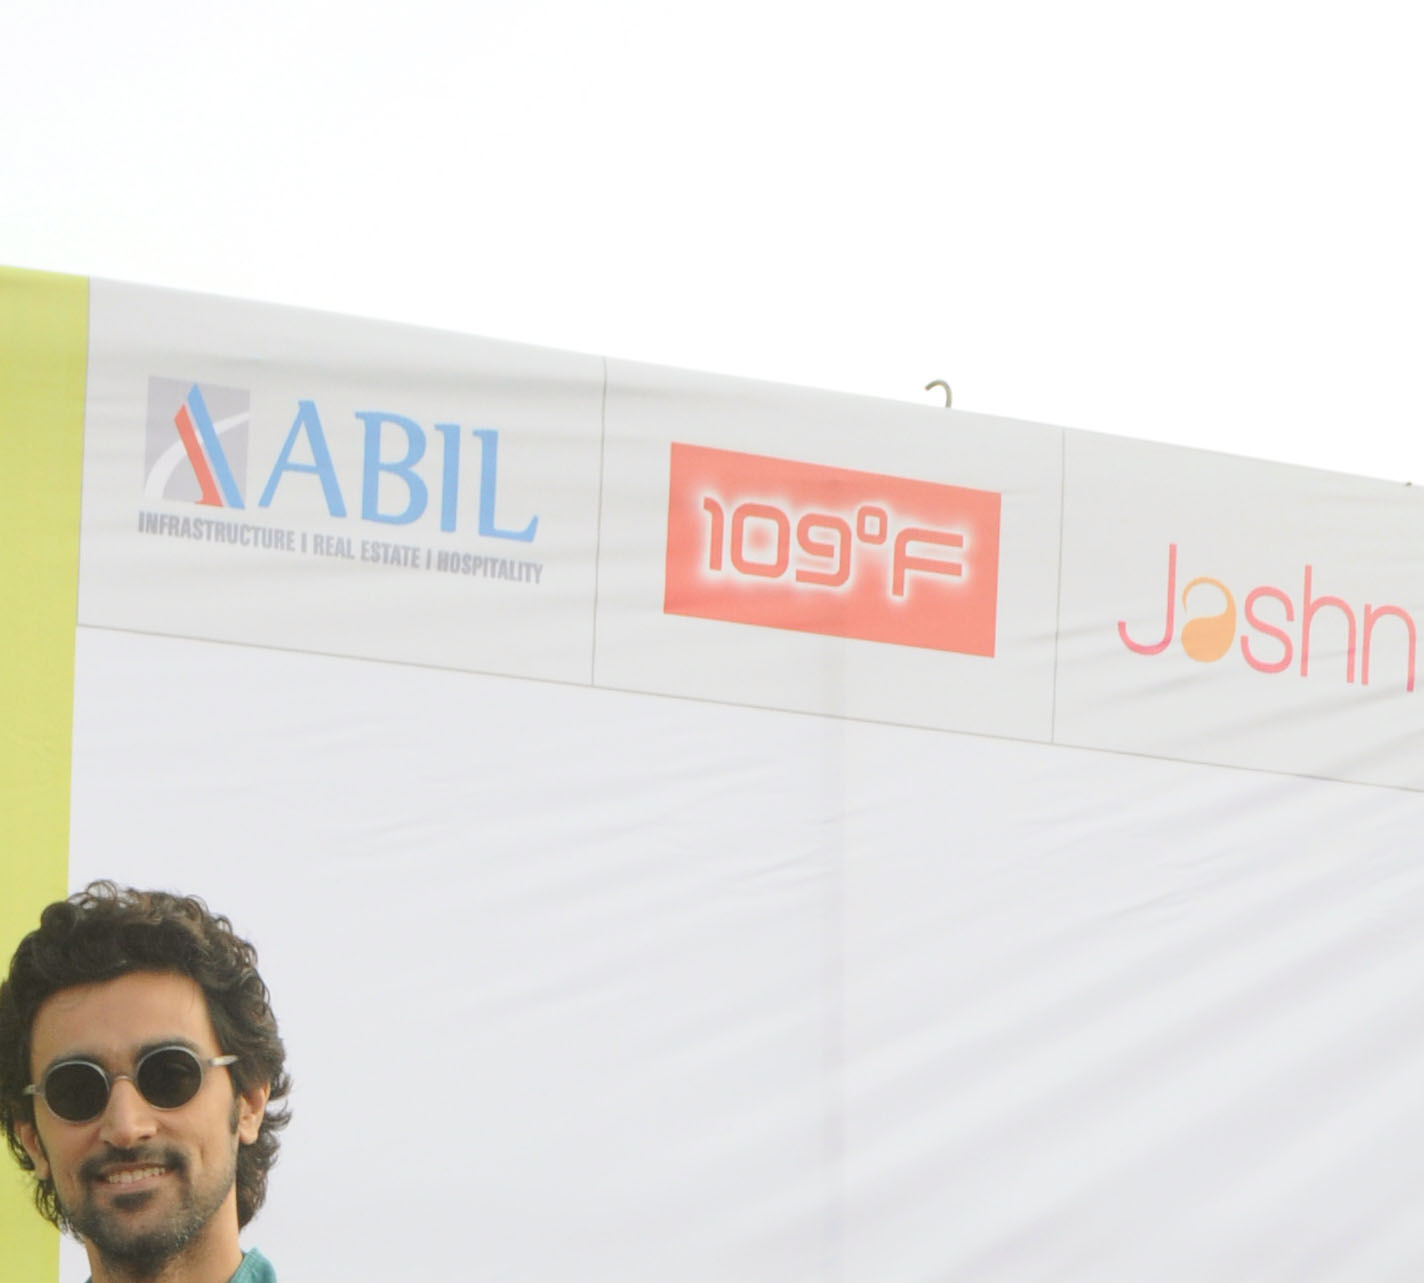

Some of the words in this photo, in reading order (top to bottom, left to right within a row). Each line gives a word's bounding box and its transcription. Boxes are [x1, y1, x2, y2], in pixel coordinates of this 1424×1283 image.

[258, 400, 539, 543] ABIL
[138, 511, 295, 553] INFRASTRUCTURE
[313, 534, 355, 561] REAL
[361, 540, 421, 570] ESTATE
[437, 550, 544, 585] HOSPITALITY
[1117, 543, 1417, 693] Jashn
